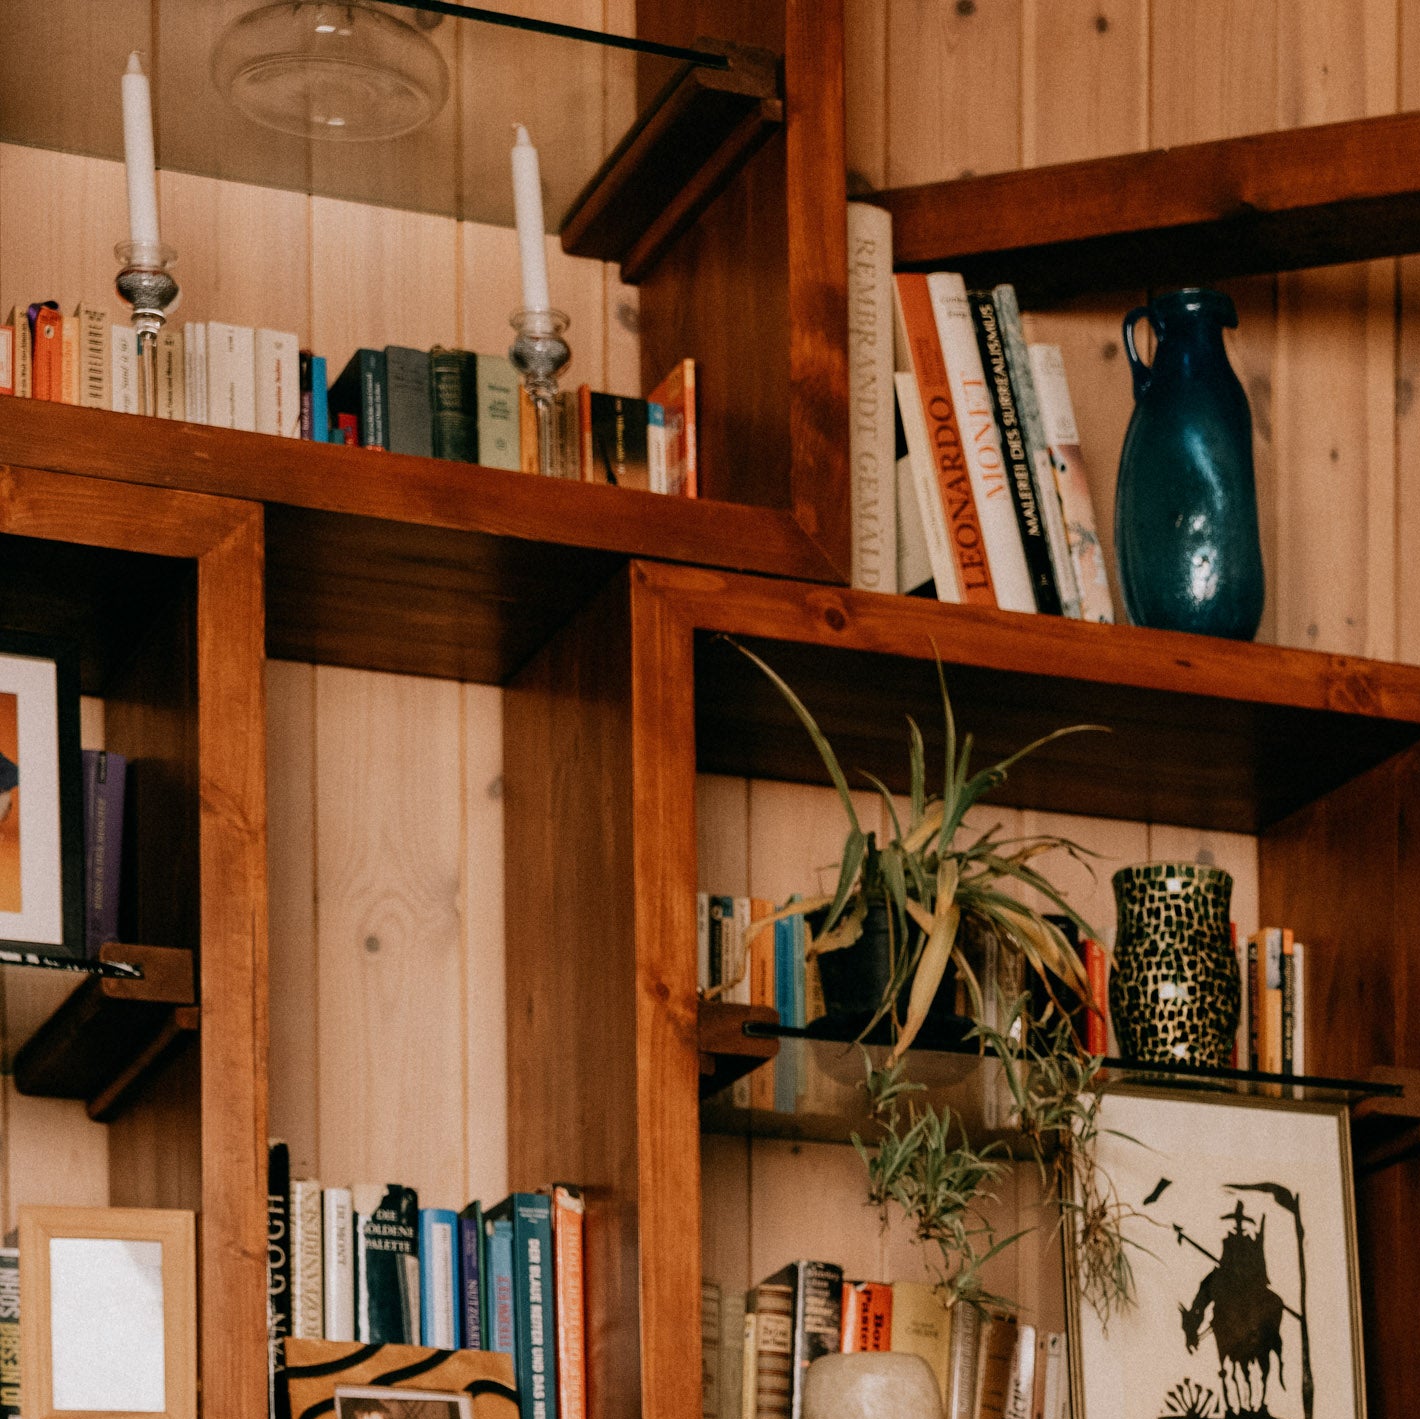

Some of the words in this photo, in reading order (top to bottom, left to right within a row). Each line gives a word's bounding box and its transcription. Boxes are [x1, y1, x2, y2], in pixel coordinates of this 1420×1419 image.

[979, 303, 1017, 426] SURREALISMUS
[958, 371, 1010, 500] MONET
[1007, 430, 1023, 460] DES
[928, 395, 989, 591] LEONARDO
[1013, 465, 1041, 536] MALEREI
[266, 1194, 286, 1295] GOGH
[376, 1209, 397, 1221] DIE
[528, 1266, 543, 1302] BLAUE
[268, 1312, 287, 1373] VAN
[532, 1375, 546, 1399] DAS
